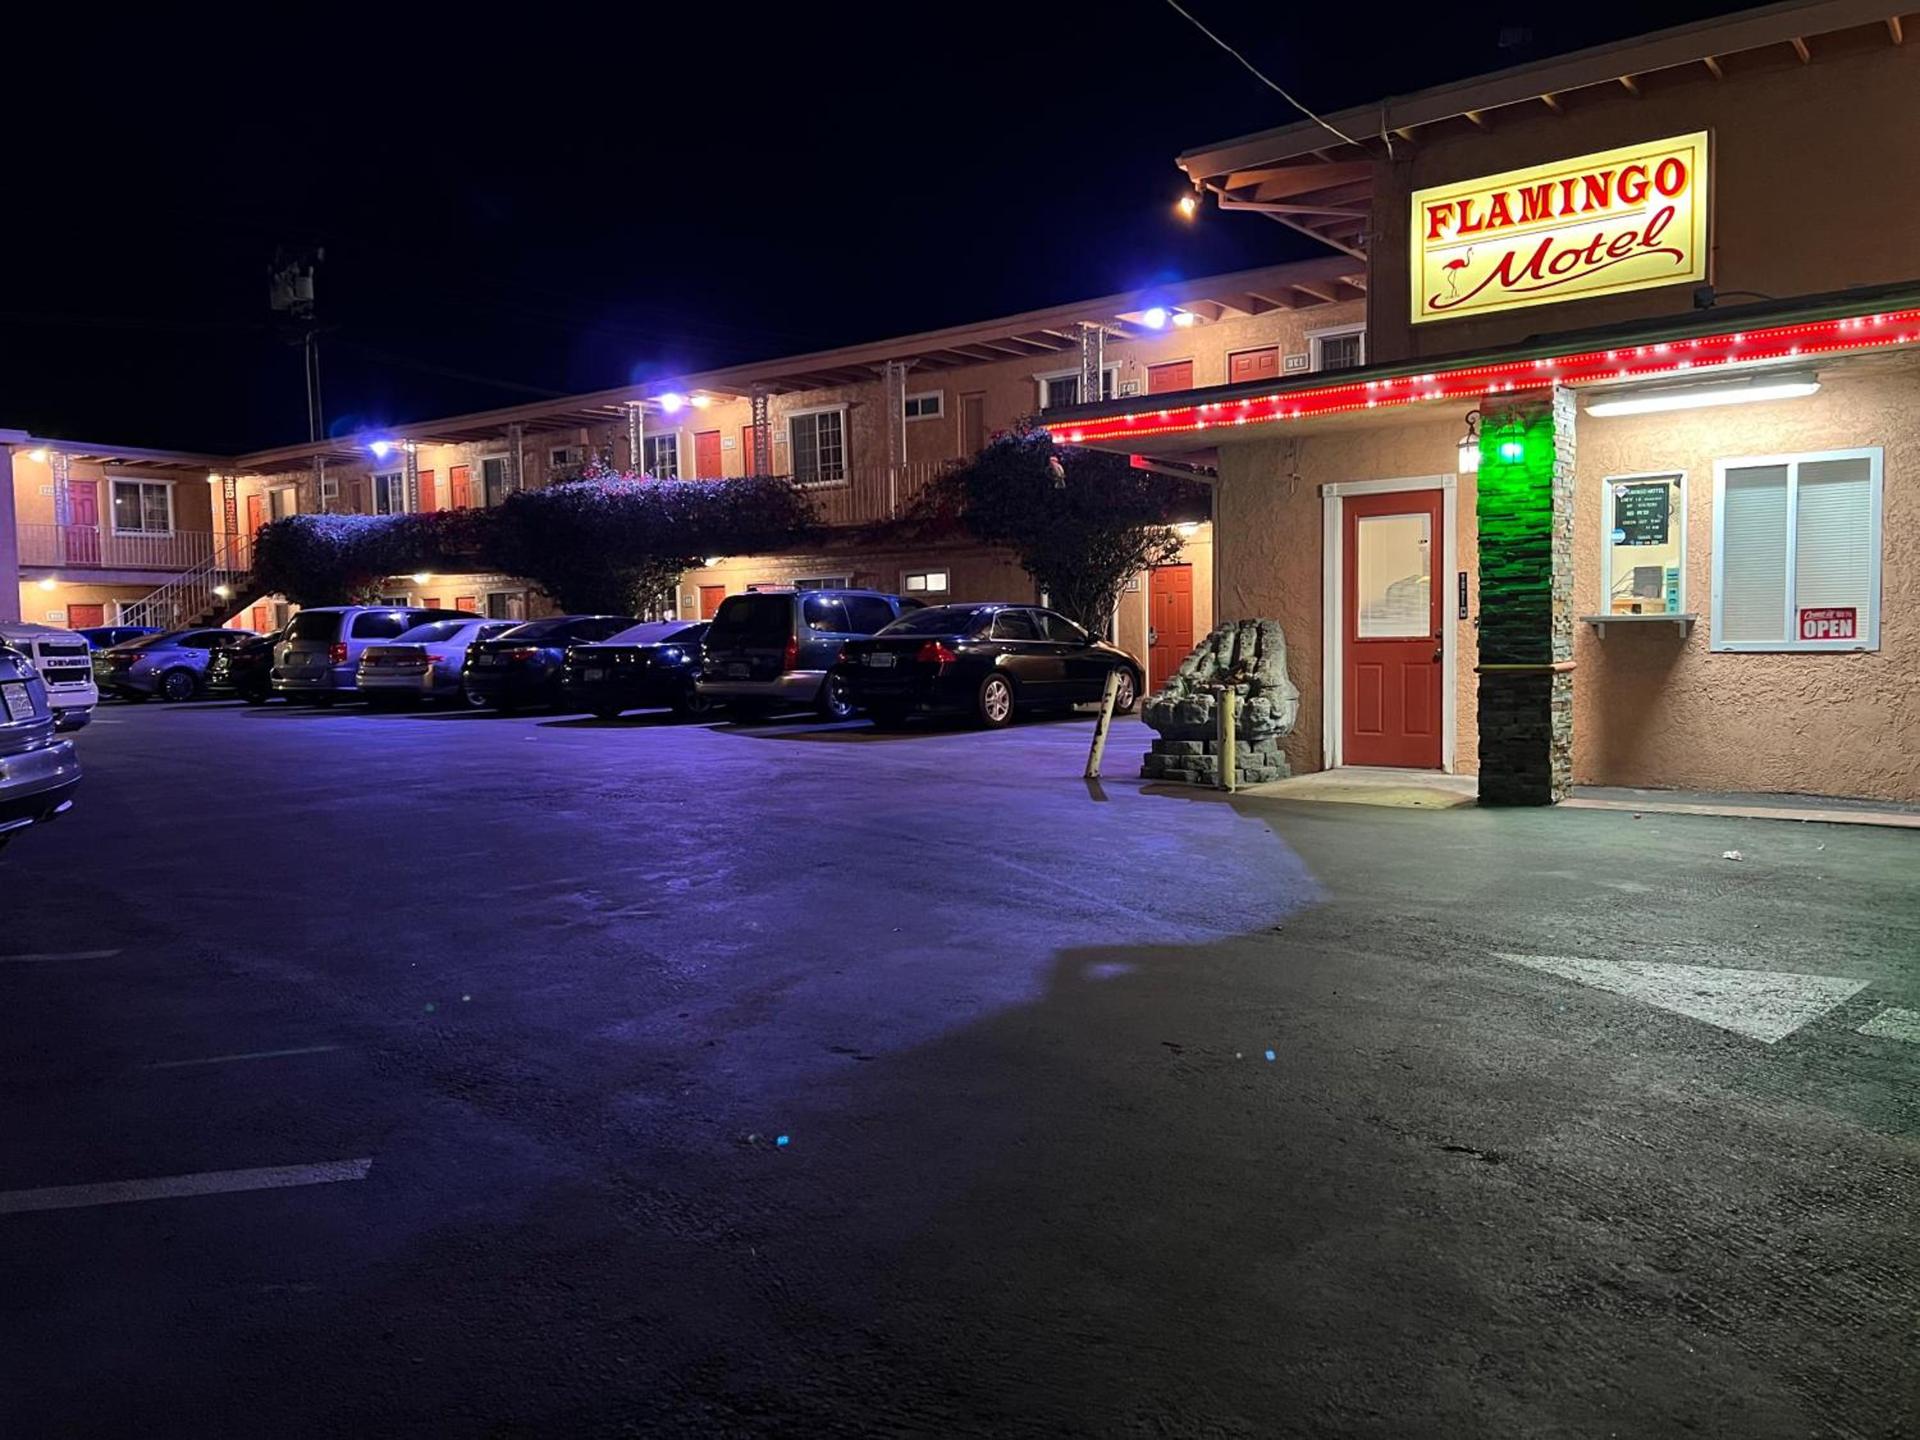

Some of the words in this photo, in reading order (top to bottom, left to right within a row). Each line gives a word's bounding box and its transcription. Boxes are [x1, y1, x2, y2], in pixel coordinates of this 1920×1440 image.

[1426, 157, 1688, 241] FLAMINGO
[1428, 205, 1676, 309] Motel
[1804, 619, 1852, 637] OPEN
